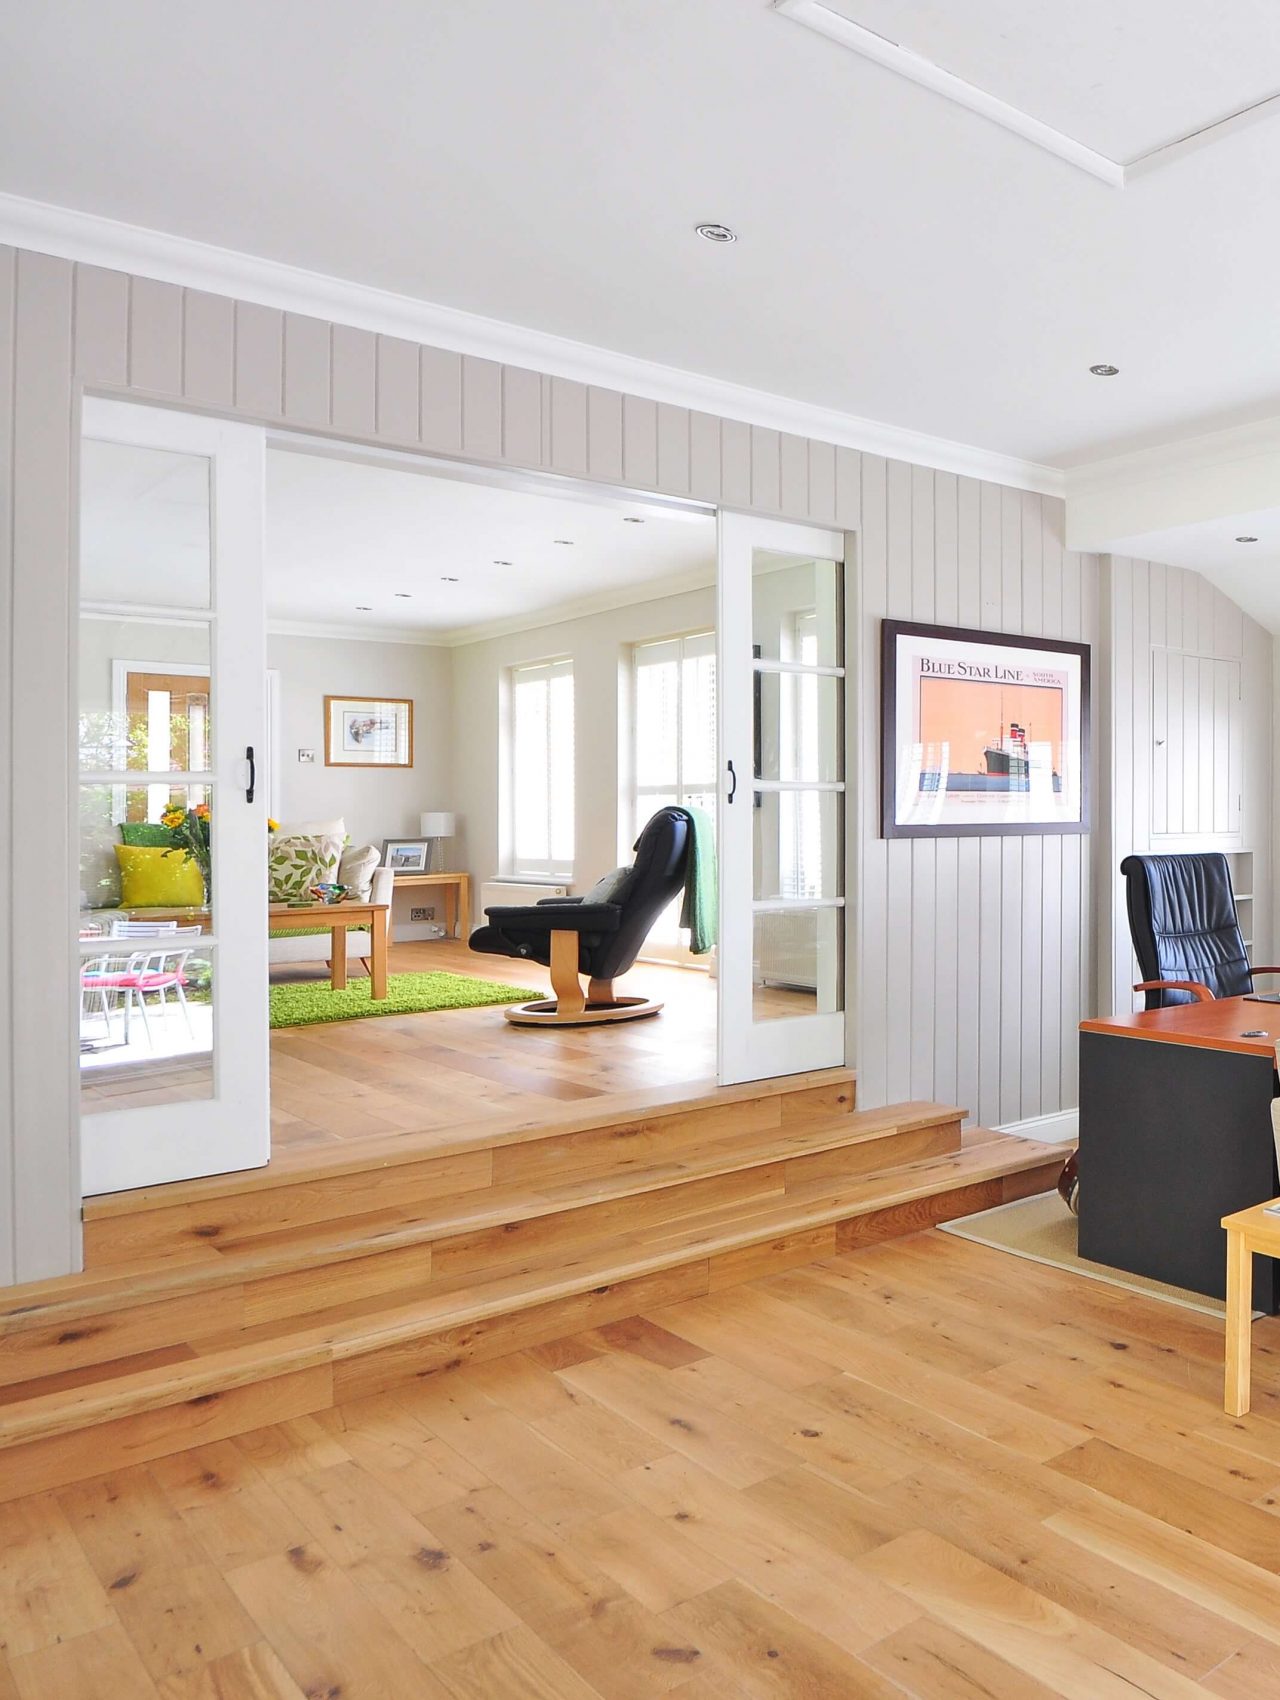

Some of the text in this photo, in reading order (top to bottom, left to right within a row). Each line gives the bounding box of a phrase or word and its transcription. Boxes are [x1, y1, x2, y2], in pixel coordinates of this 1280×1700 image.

[920, 658, 1024, 681] BLUE STAR LINE
[1033, 677, 1063, 685] AMERICA
